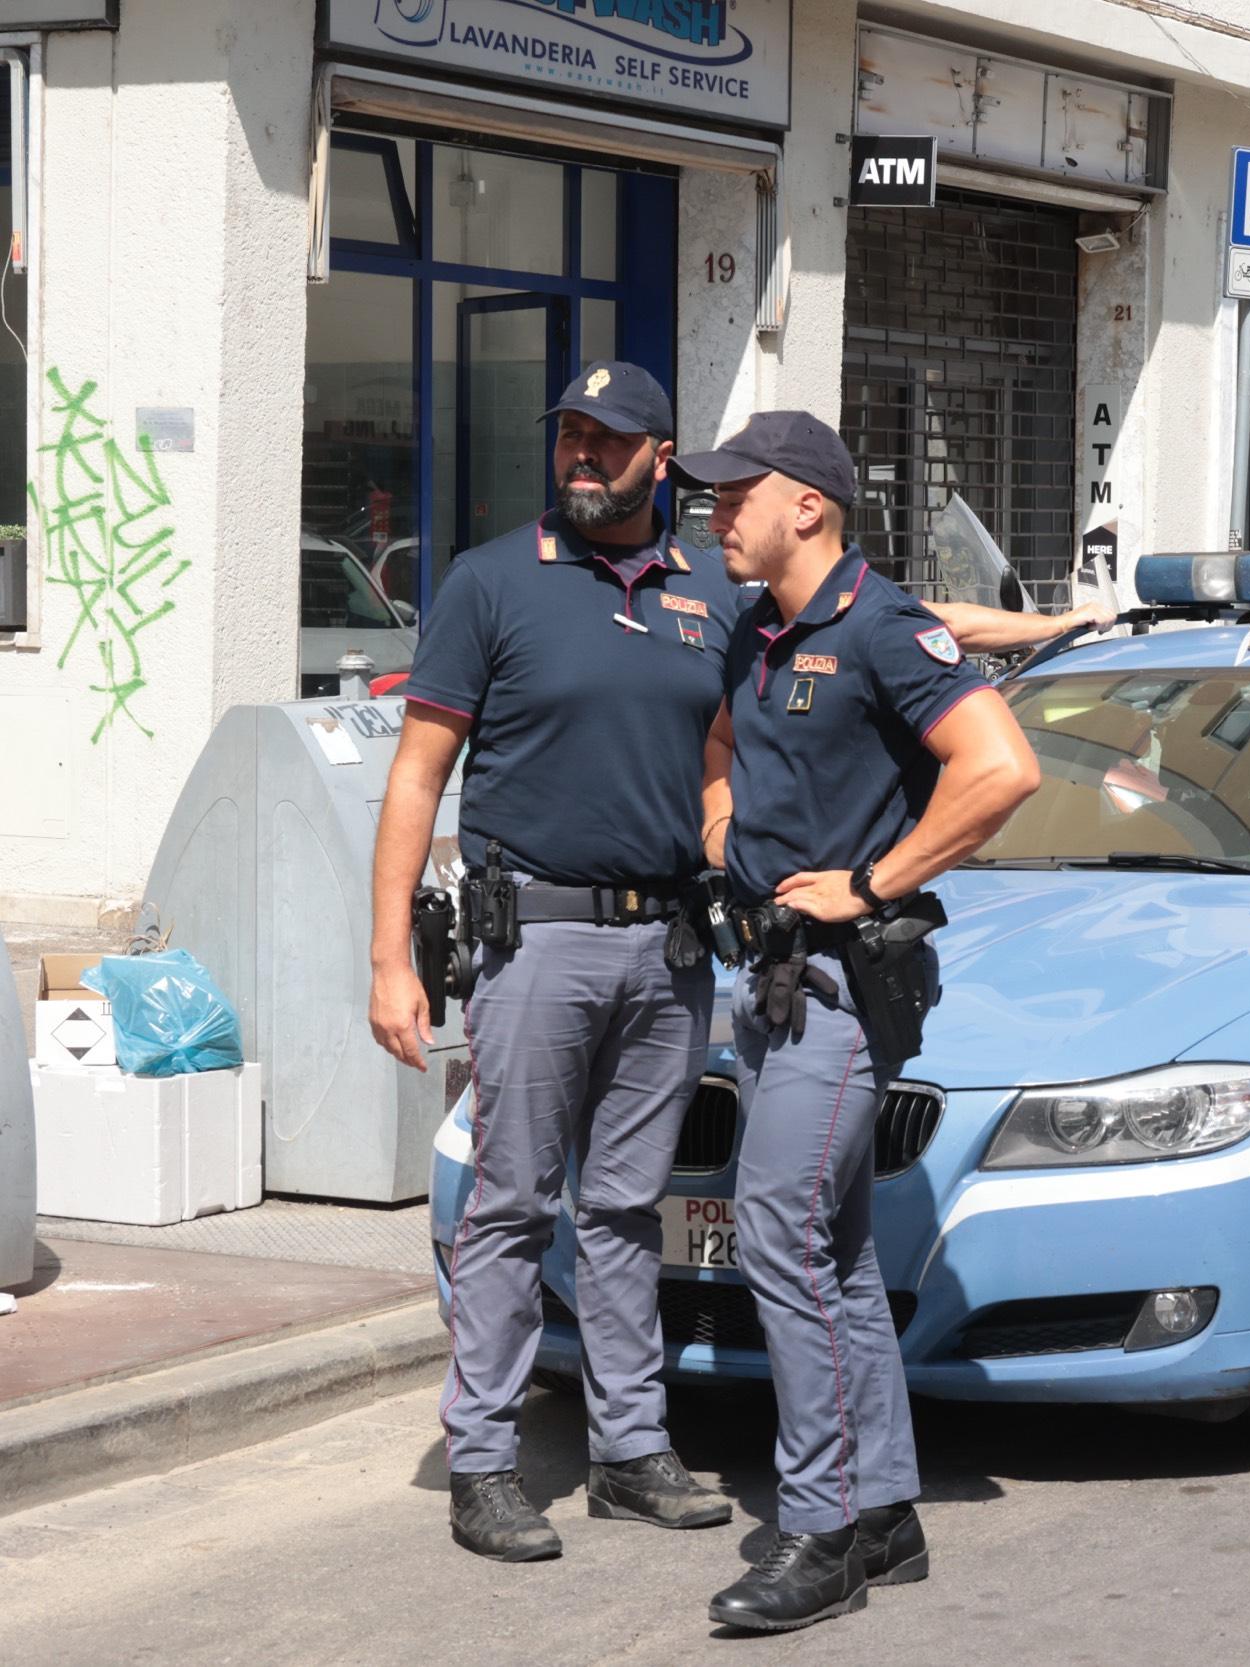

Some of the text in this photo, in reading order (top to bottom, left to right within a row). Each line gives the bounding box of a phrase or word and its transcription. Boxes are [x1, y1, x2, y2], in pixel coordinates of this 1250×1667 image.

[450, 22, 749, 99] LAVANDERIA SELF SERVICE
[858, 158, 926, 184] ATM
[704, 252, 736, 283] 19
[1114, 305, 1132, 321] 21
[1090, 403, 1112, 504] ATM
[1087, 545, 1113, 555] HERE
[662, 595, 707, 616] POLIZIA
[796, 655, 836, 673] POLIZIA
